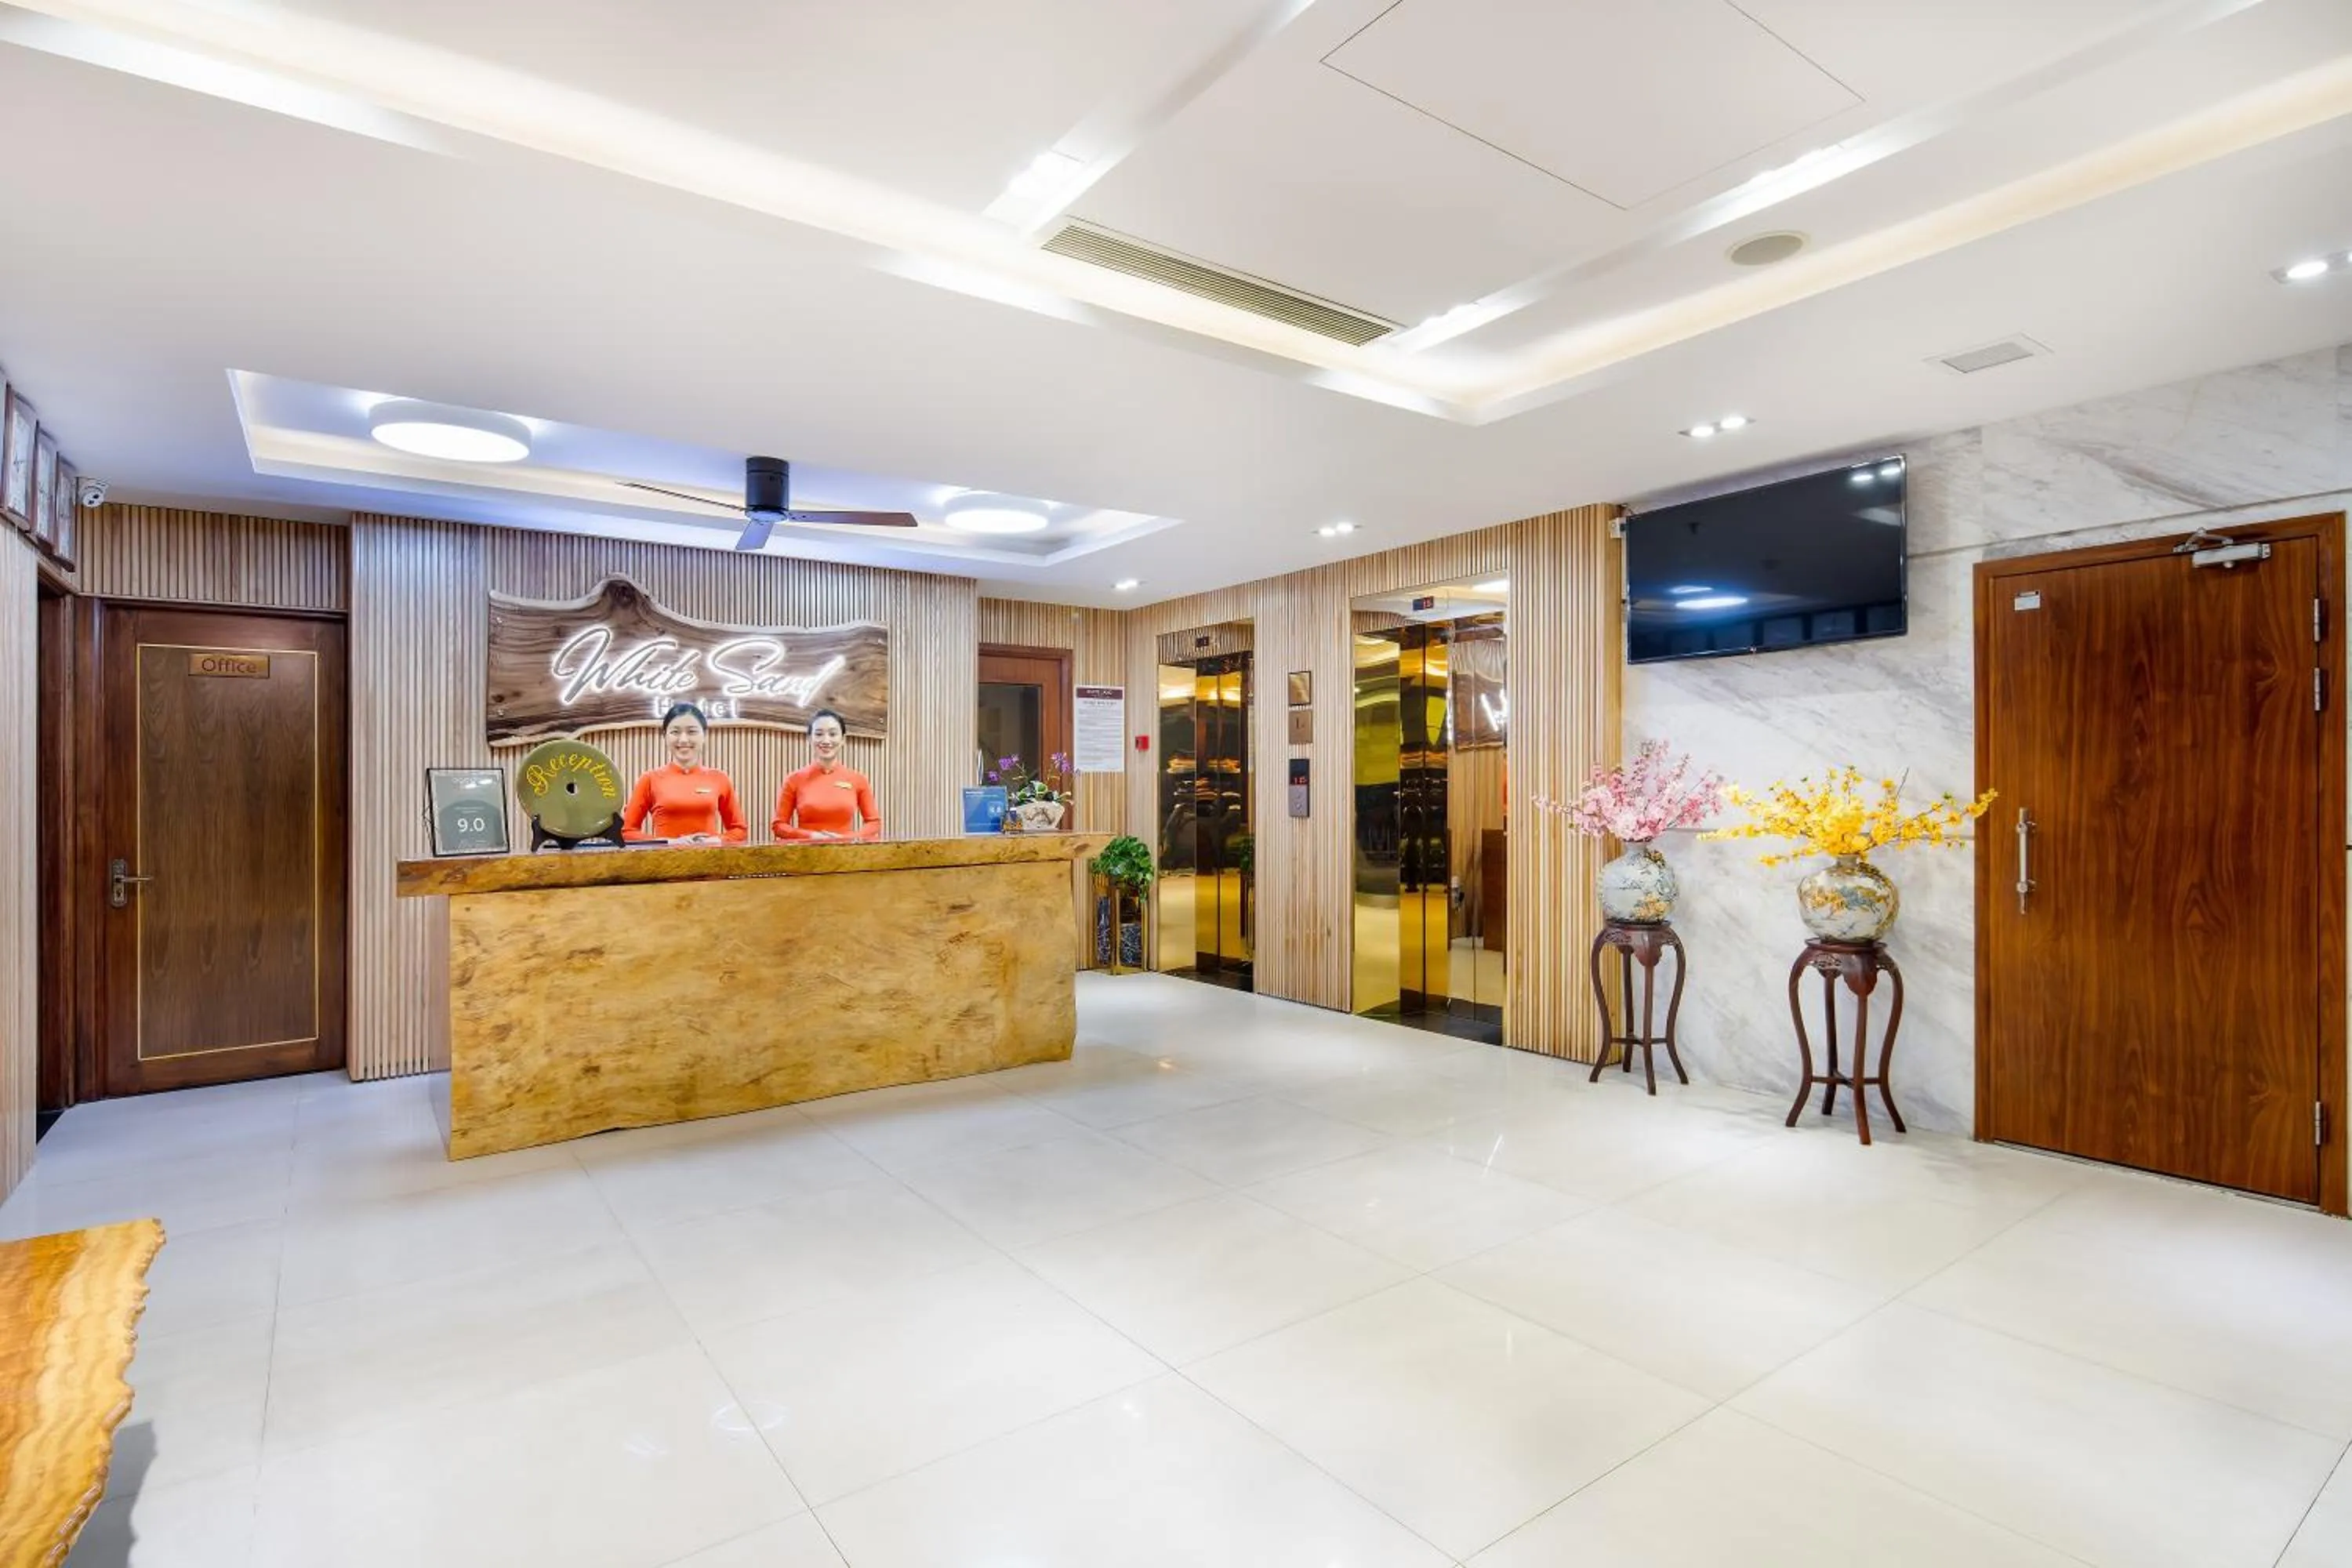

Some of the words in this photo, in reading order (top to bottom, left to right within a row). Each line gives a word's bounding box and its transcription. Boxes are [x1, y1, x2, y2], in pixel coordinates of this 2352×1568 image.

[201, 657, 257, 673] Office
[552, 626, 702, 705] White
[709, 636, 847, 707] Sand
[654, 695, 739, 718] Htel
[526, 752, 616, 798] Reception
[457, 818, 485, 832] 9.0
